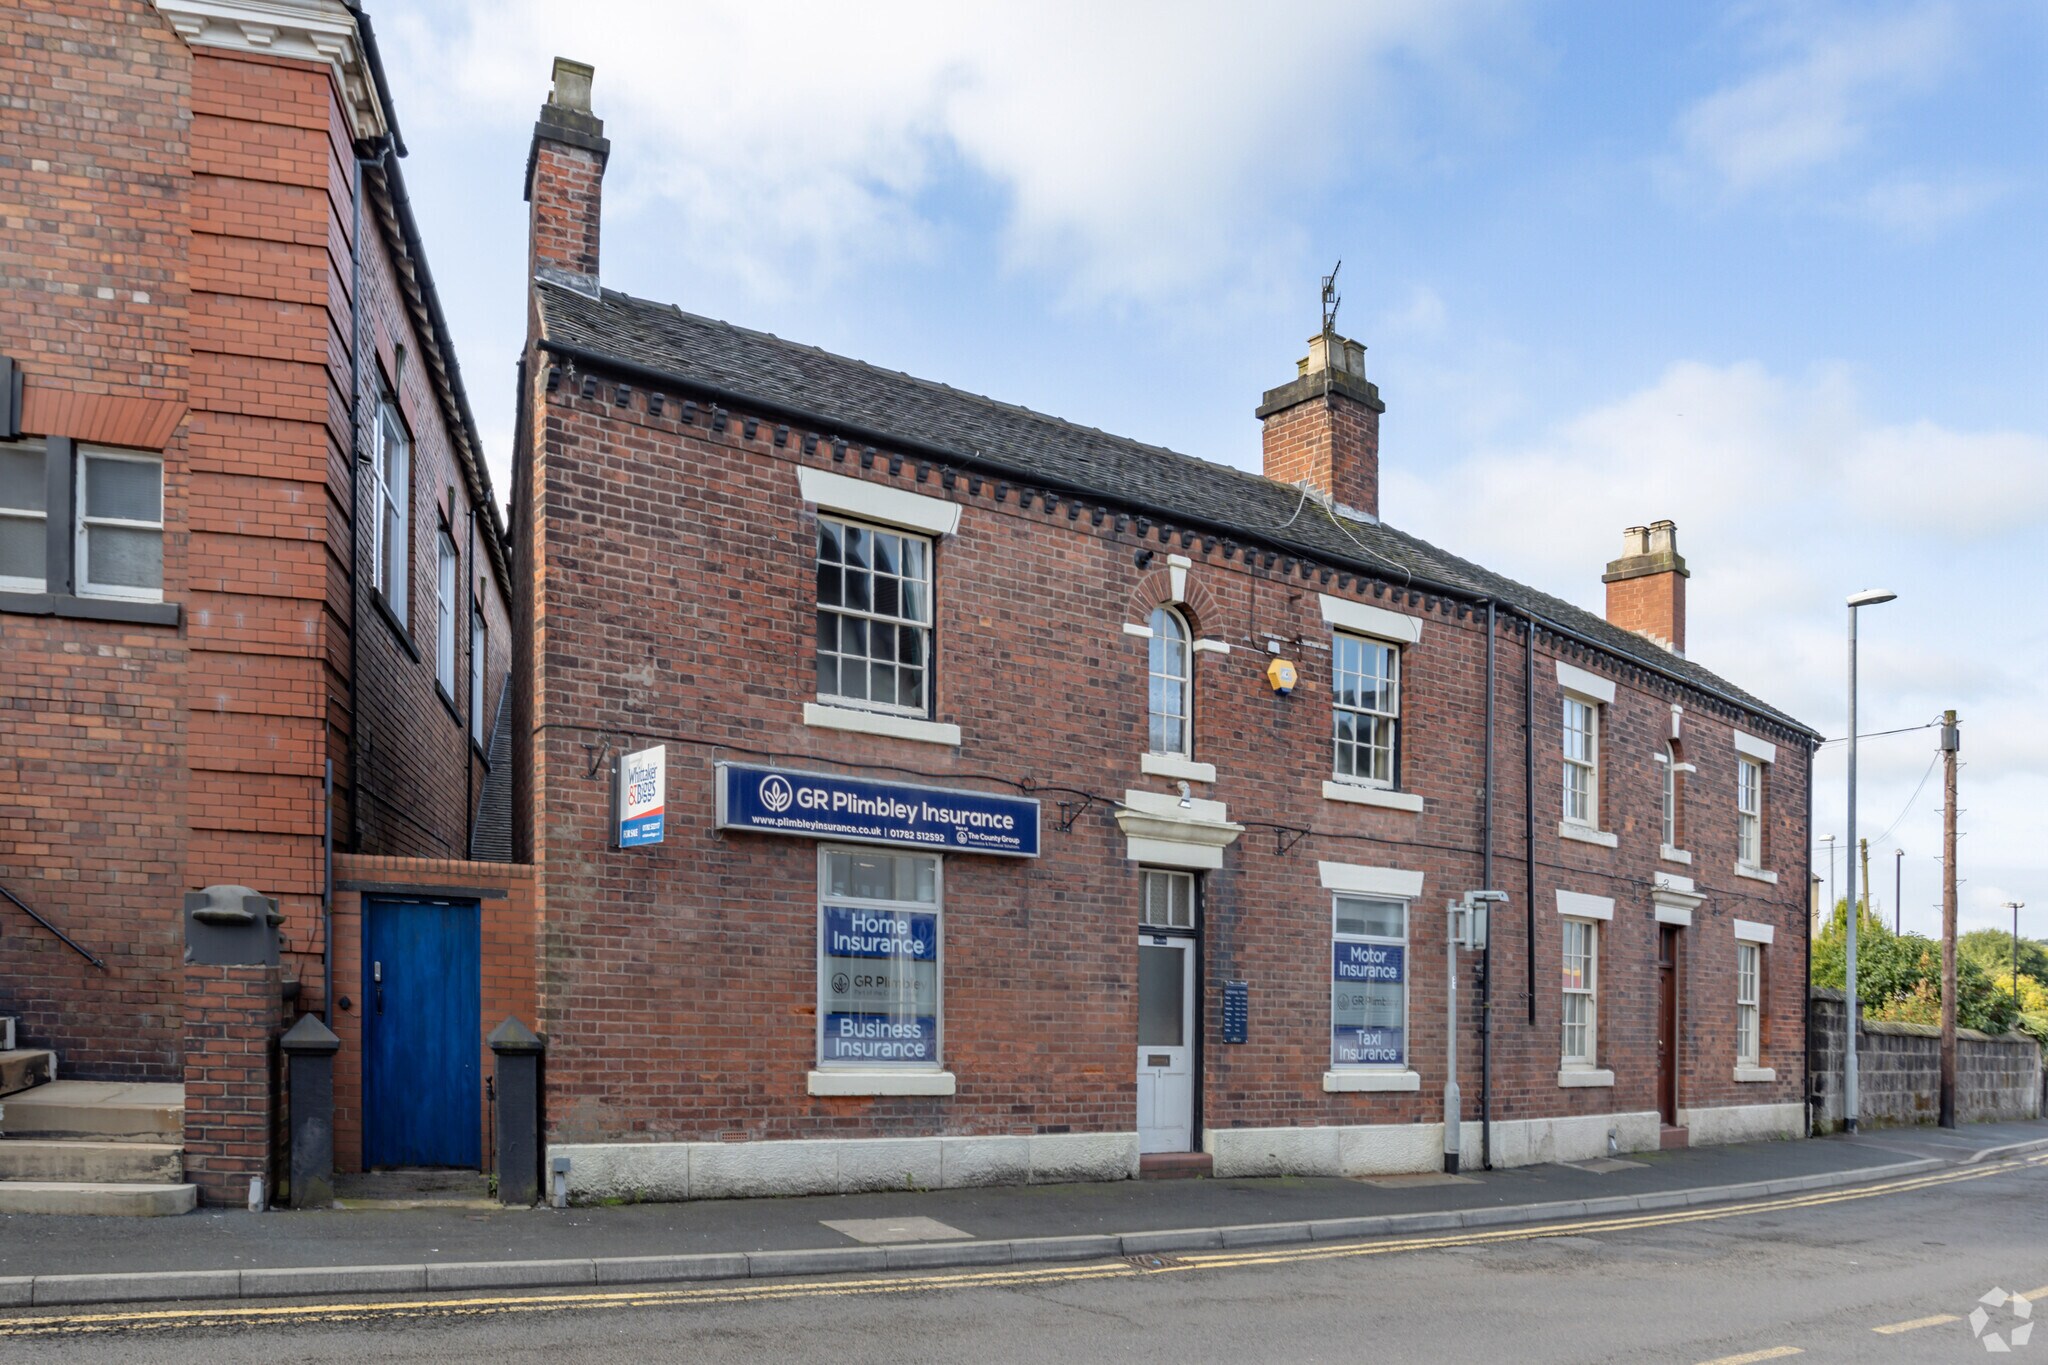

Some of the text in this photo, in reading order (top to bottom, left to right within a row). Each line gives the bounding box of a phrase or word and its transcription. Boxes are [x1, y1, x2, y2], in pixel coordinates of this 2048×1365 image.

[628, 764, 658, 785] Whittaker
[636, 780, 656, 805] Biggs
[797, 787, 1014, 829] GR Plimbley Insurance
[751, 816, 945, 842] www.plimbleyinsurance.co.uk 01782 512592
[968, 832, 1020, 845] The County Group
[852, 913, 908, 935] Home
[833, 931, 925, 954] Insurance
[1350, 947, 1387, 963] Motor
[1339, 961, 1397, 979] Insurance
[854, 975, 873, 988] GR
[1351, 995, 1365, 1006] GR
[840, 1018, 922, 1039] Business
[1356, 1030, 1382, 1045] Taxi
[835, 1038, 926, 1058] Insurance
[1339, 1046, 1397, 1061] Insurance
